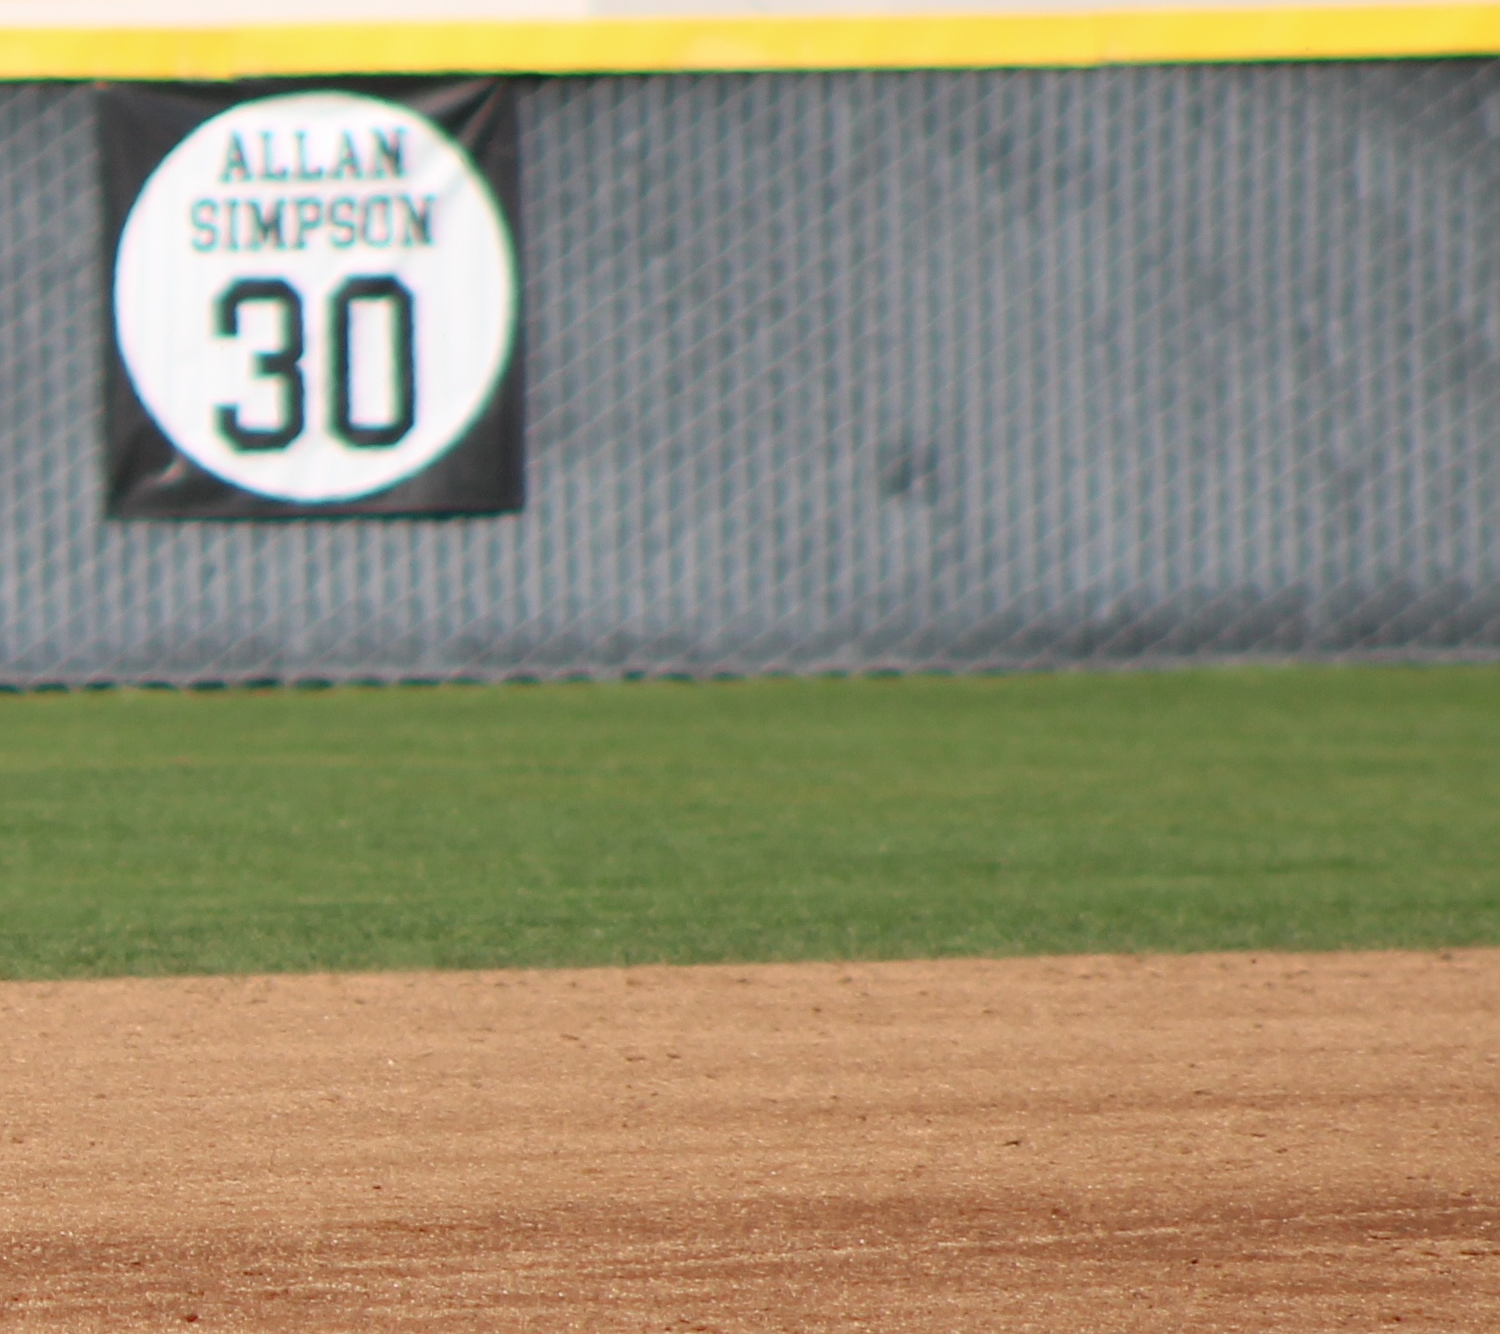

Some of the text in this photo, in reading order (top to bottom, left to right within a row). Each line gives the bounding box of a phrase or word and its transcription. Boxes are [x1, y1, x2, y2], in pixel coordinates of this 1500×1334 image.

[219, 127, 409, 183] ALLAN
[190, 194, 437, 252] SIMPSON
[213, 275, 417, 454] 30
